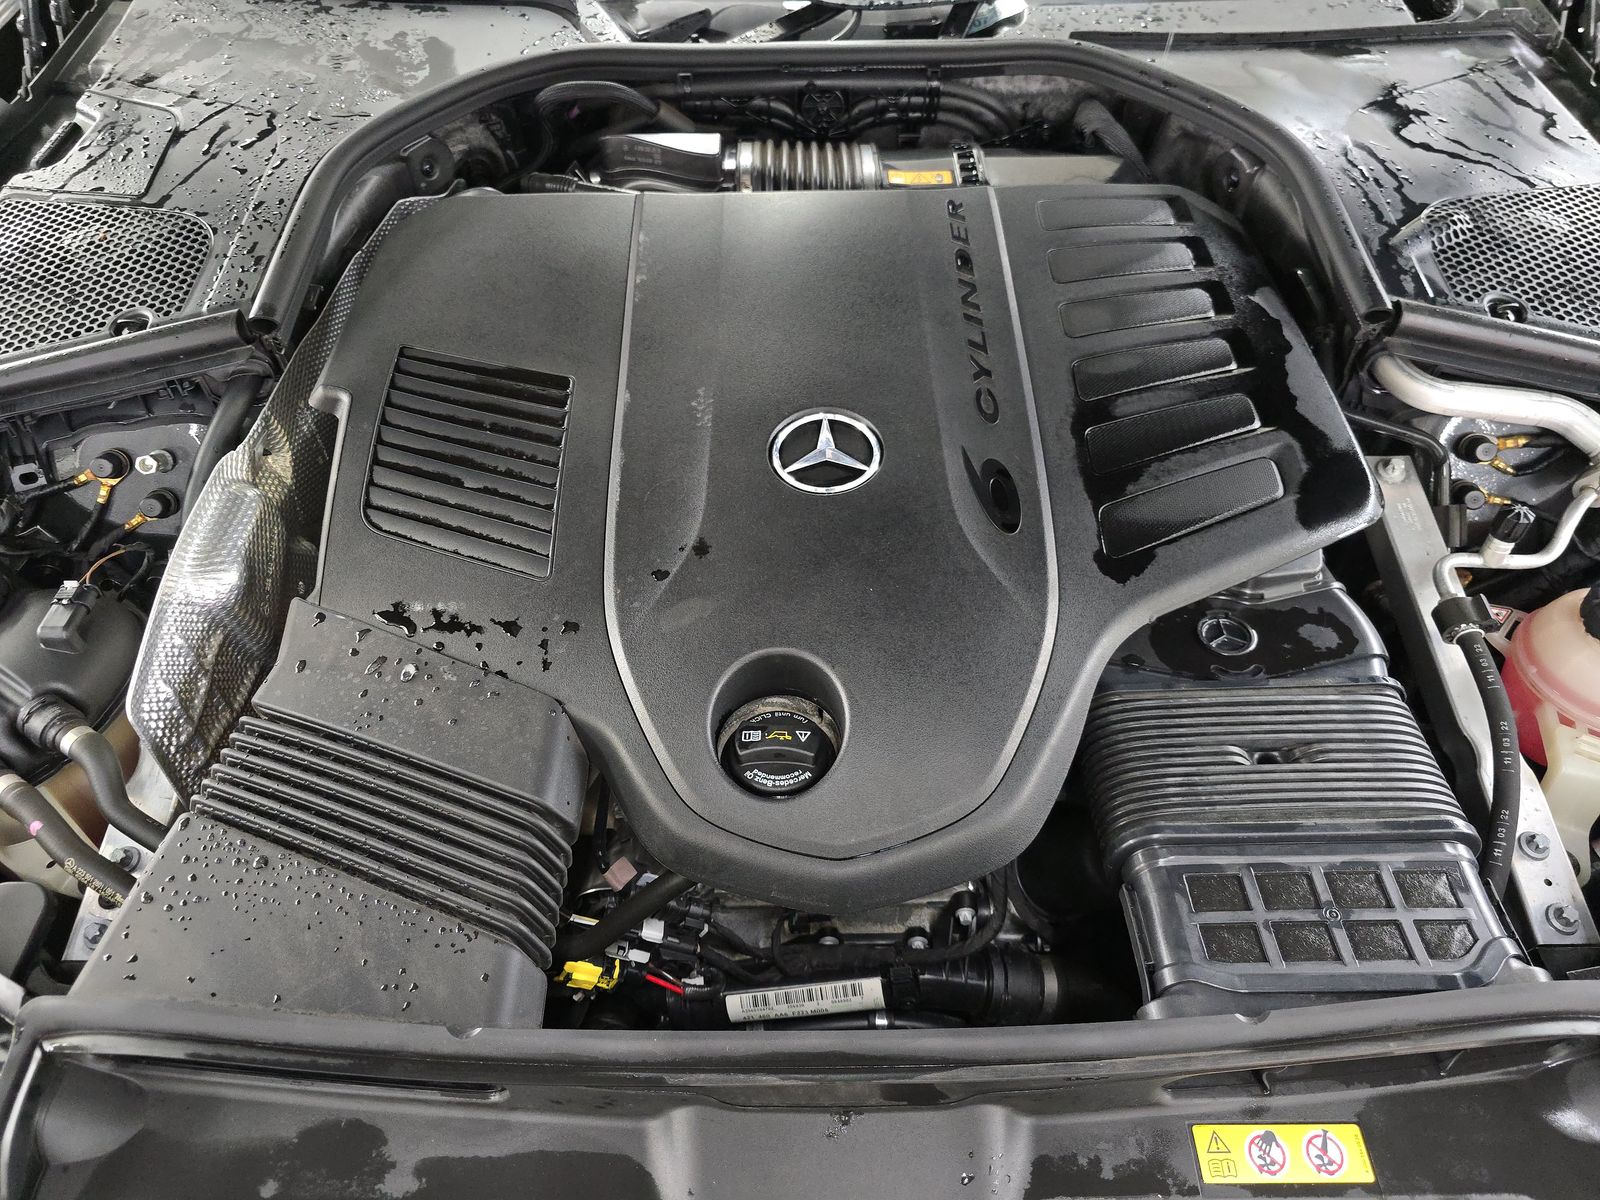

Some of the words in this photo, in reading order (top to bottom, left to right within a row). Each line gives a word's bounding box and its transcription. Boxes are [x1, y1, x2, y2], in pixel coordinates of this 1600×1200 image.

[947, 198, 1000, 425] CYLINDER
[961, 444, 1023, 535] 6
[743, 770, 754, 780] Oil
[752, 768, 803, 780] recommended
[754, 770, 812, 787] Mercedes-Benz
